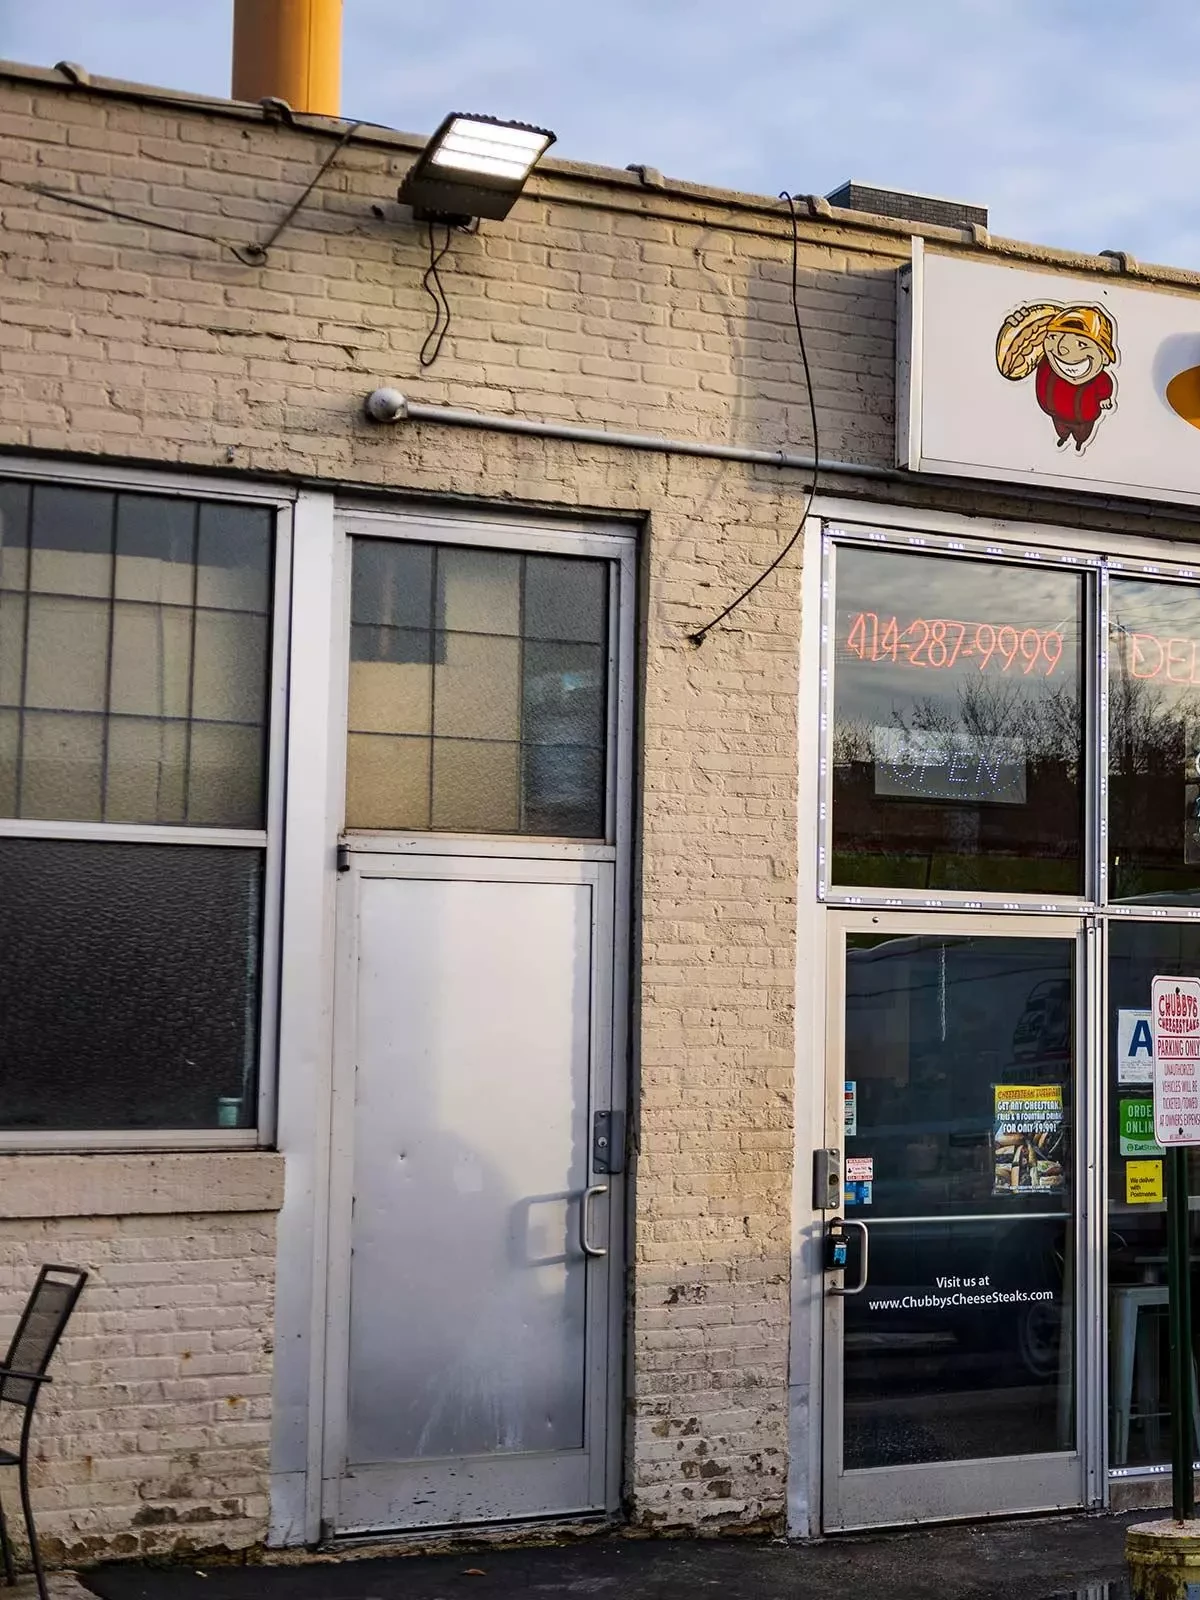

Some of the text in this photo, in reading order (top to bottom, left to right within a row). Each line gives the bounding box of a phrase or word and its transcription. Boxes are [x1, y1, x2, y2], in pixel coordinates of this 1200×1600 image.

[848, 613, 1064, 676] 414-287-9999
[892, 747, 1003, 784] OPEN
[1128, 1020, 1153, 1057] A
[1157, 1039, 1200, 1057] PARKING ONLY
[1192, 1080, 1198, 1093] BE
[997, 1101, 1010, 1111] GET
[1010, 1101, 1023, 1111] ANY
[1128, 1105, 1153, 1117] ORDE
[1003, 1123, 1017, 1133] FOR
[1017, 1123, 1034, 1133] ONLY
[1126, 1121, 1155, 1133] ONLIN
[936, 1275, 990, 1288] Visit us at
[869, 1290, 1053, 1310] www.ChubbysCheeseSteaks.com
